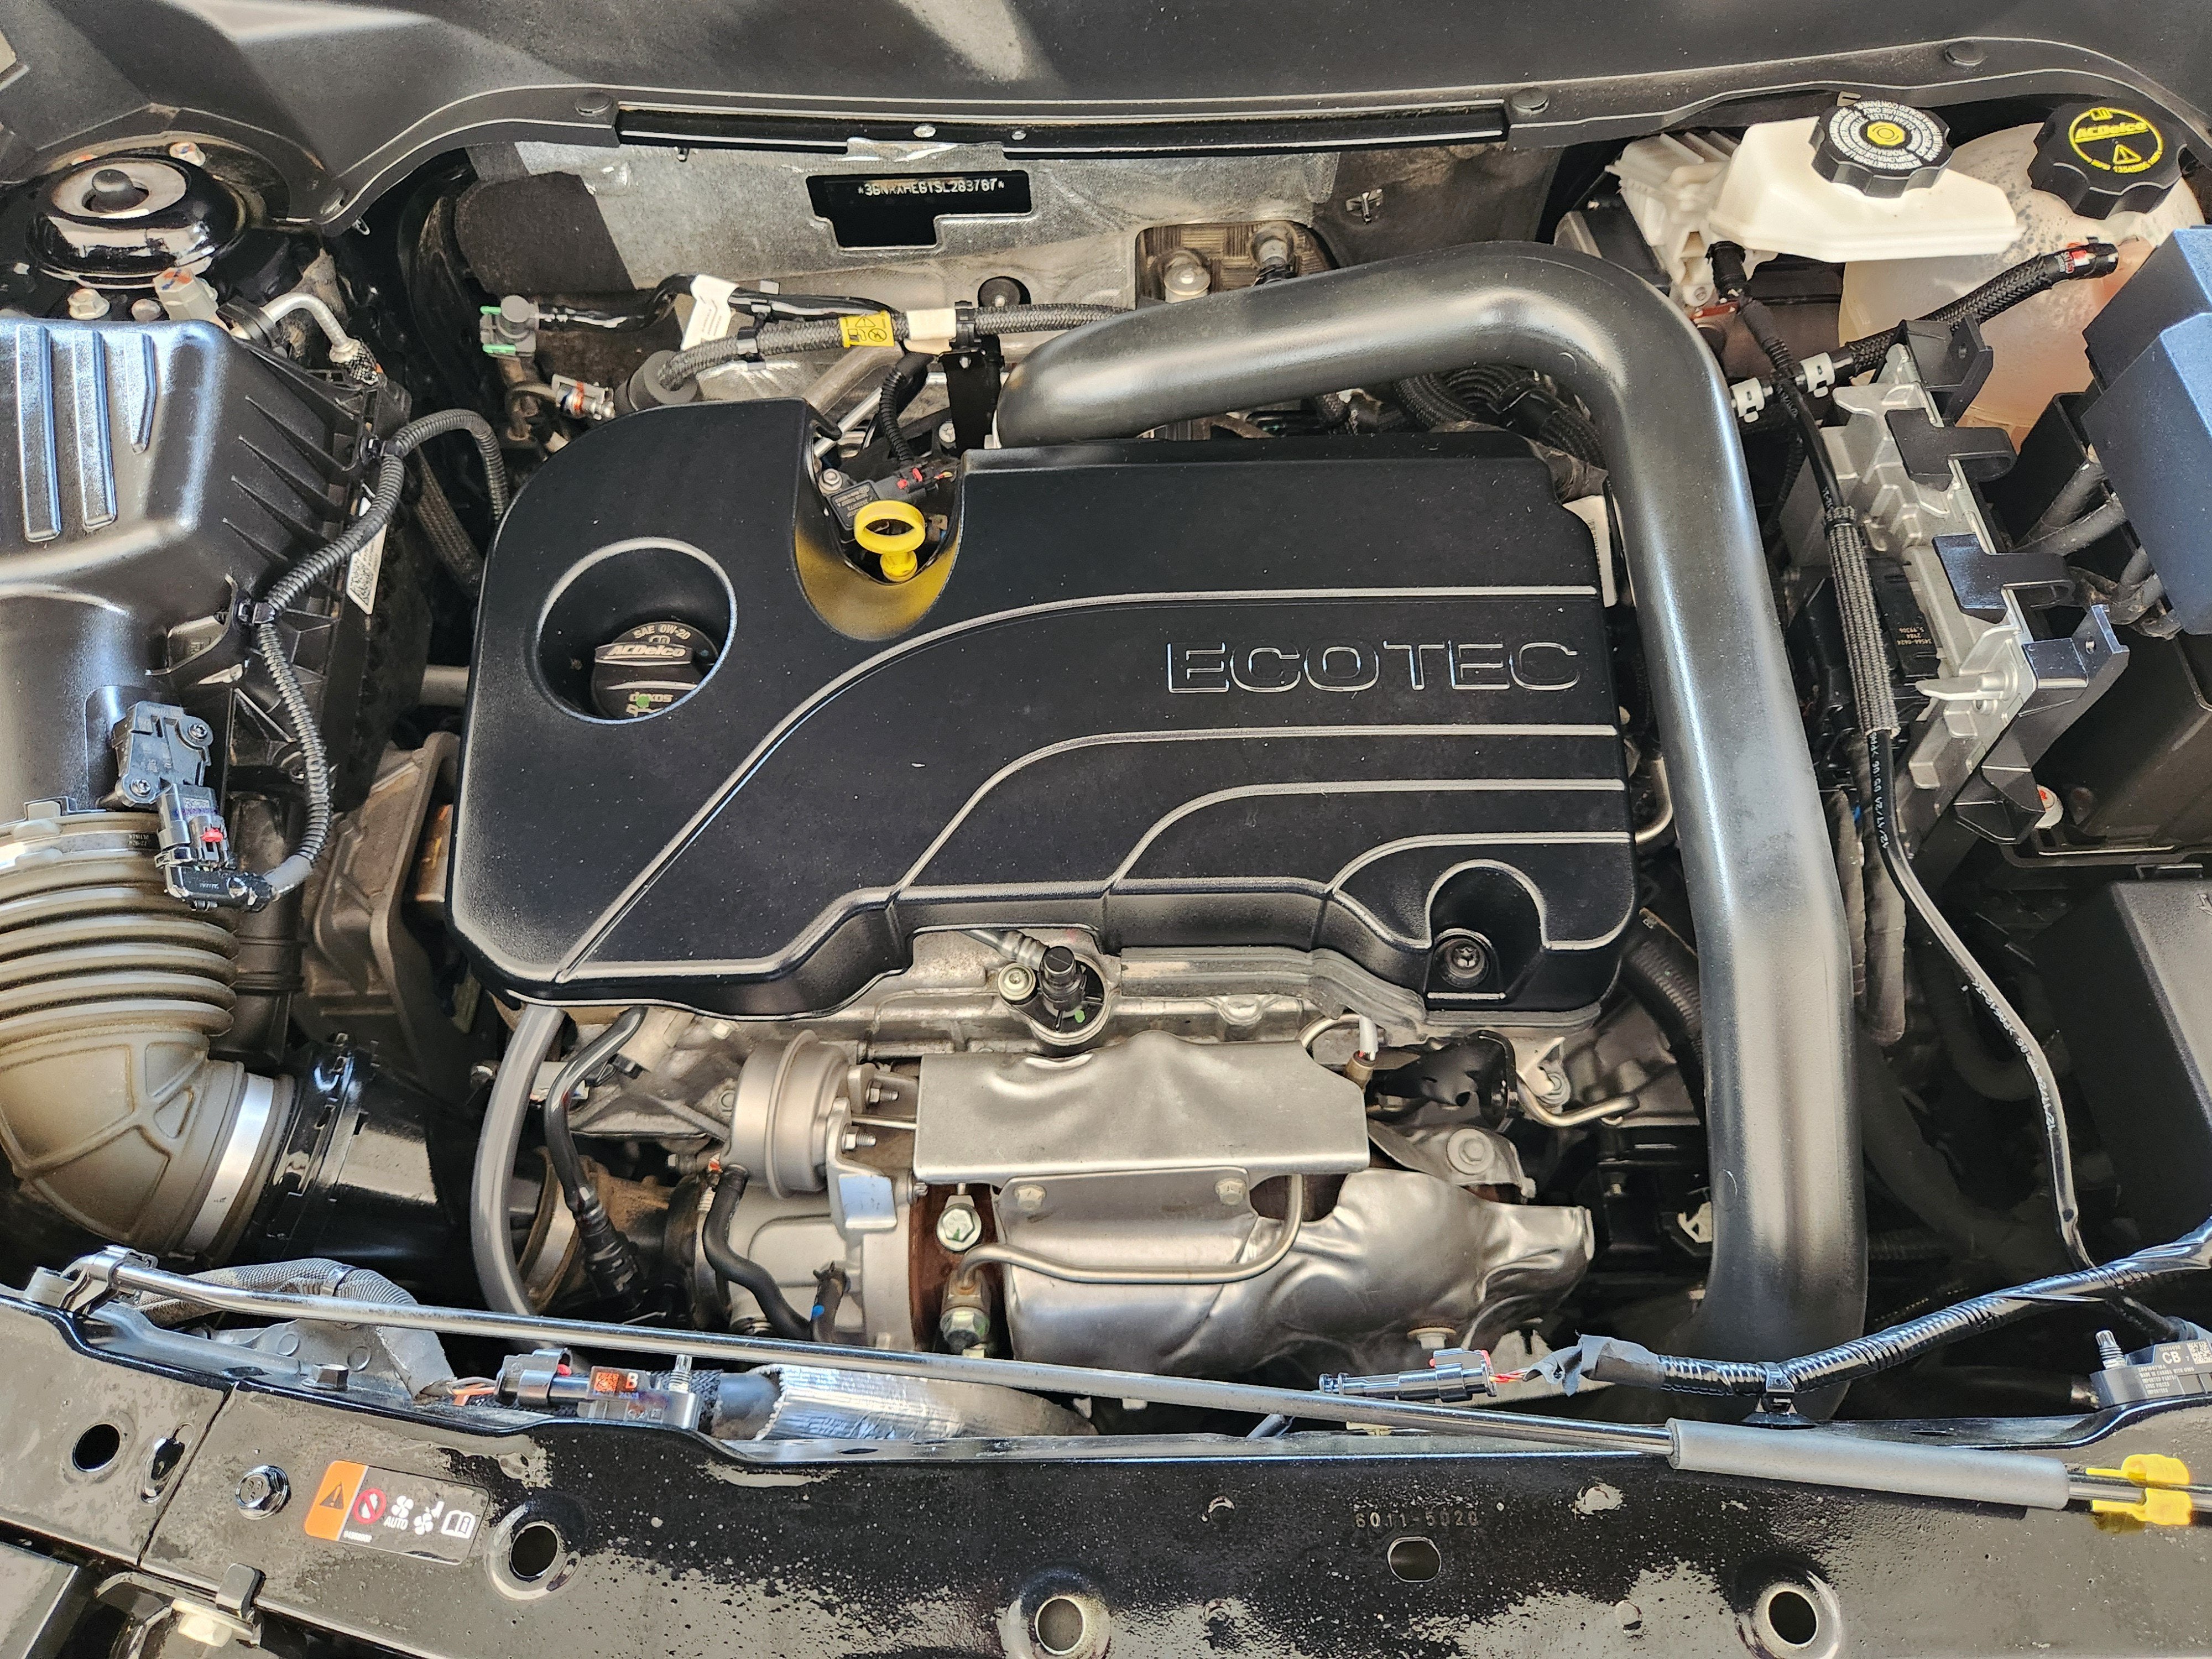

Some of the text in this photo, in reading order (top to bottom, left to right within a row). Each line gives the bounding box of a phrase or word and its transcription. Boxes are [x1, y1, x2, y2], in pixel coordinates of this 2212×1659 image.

[2075, 122, 2148, 139] ACDelco
[633, 625, 655, 639] SAE
[608, 645, 686, 657] ACDelco
[1166, 639, 1579, 693] ECOTEC
[628, 691, 674, 702] dxos
[2162, 1351, 2182, 1364] CB
[625, 1371, 639, 1389] B
[383, 1515, 409, 1531] AUTO
